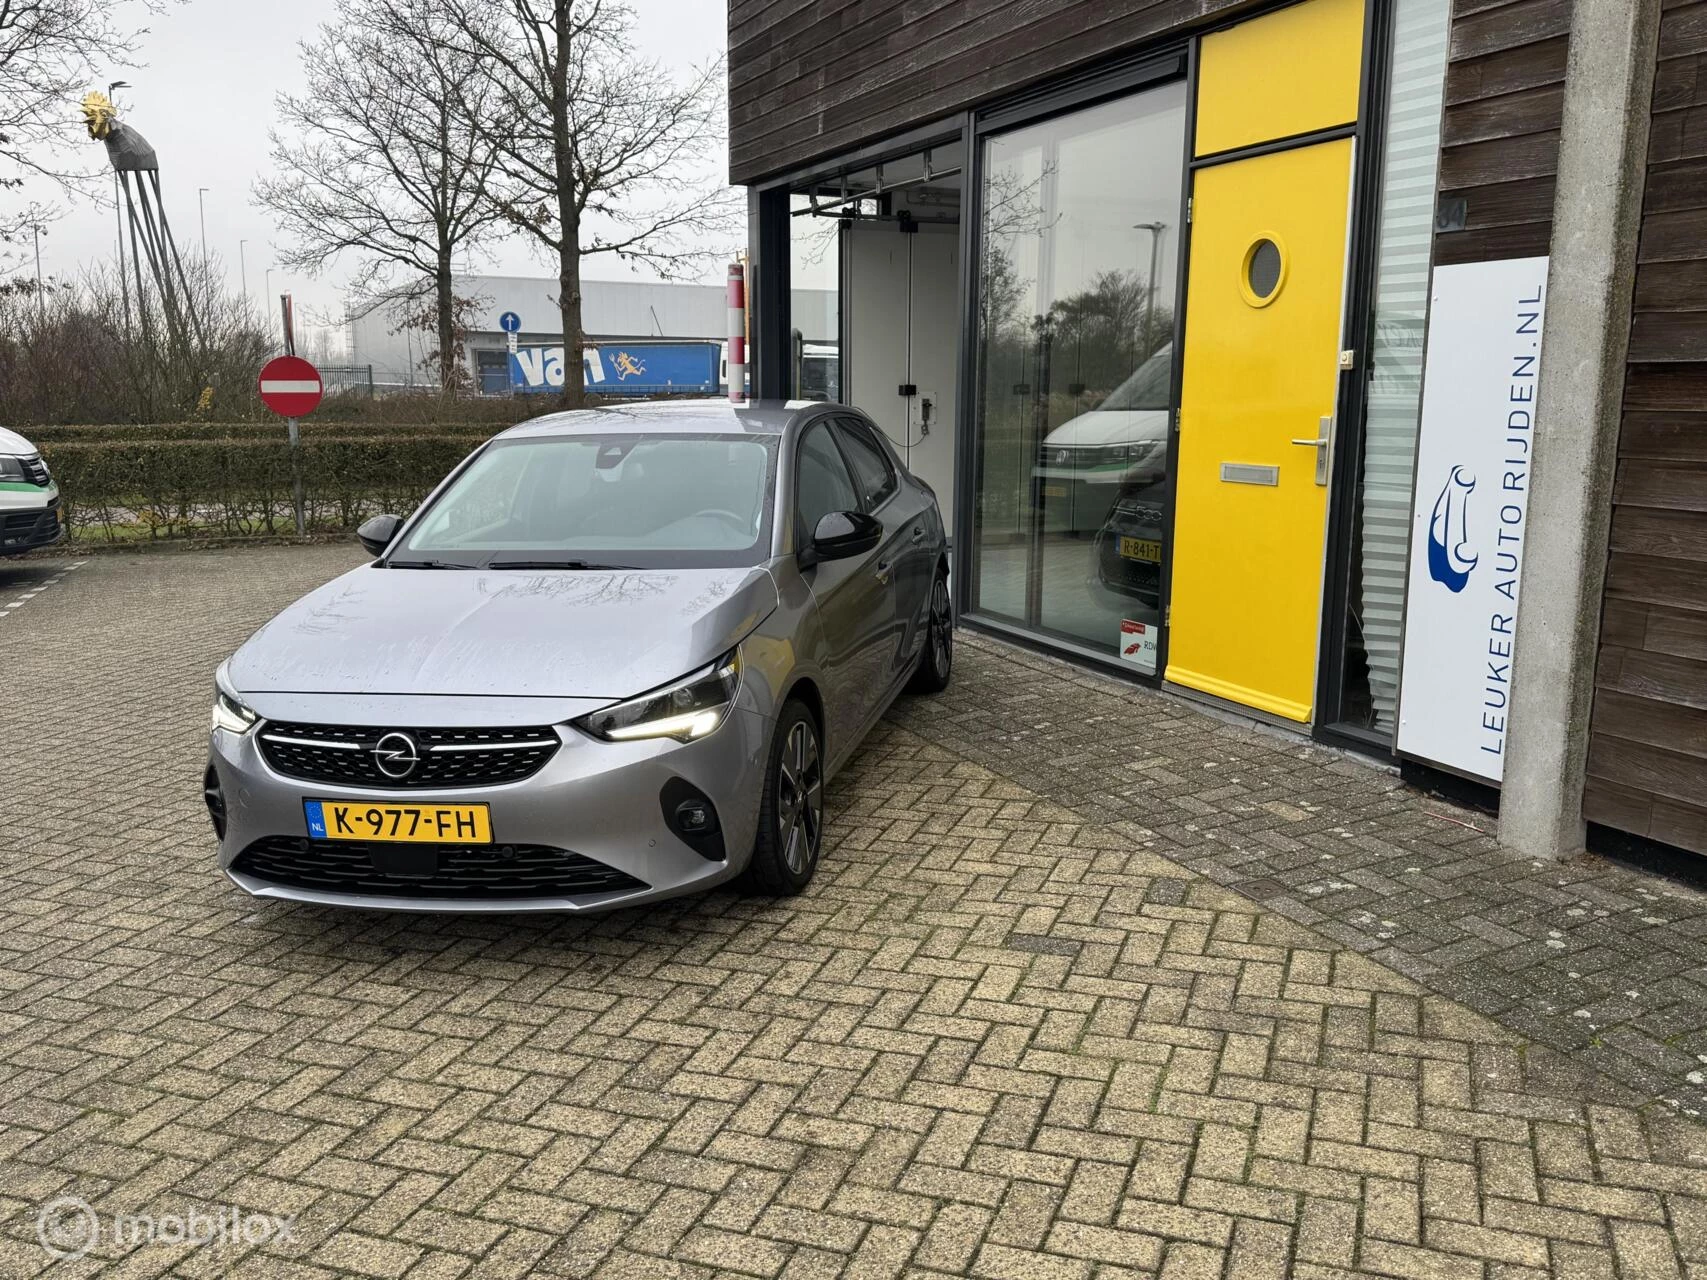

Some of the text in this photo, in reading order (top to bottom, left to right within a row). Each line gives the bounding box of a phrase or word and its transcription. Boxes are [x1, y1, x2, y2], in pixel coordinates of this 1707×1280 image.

[516, 347, 605, 386] van
[1481, 285, 1542, 754] LEUKER AUTO RIJDEN.NL
[312, 807, 476, 838] NL K-977-FH
